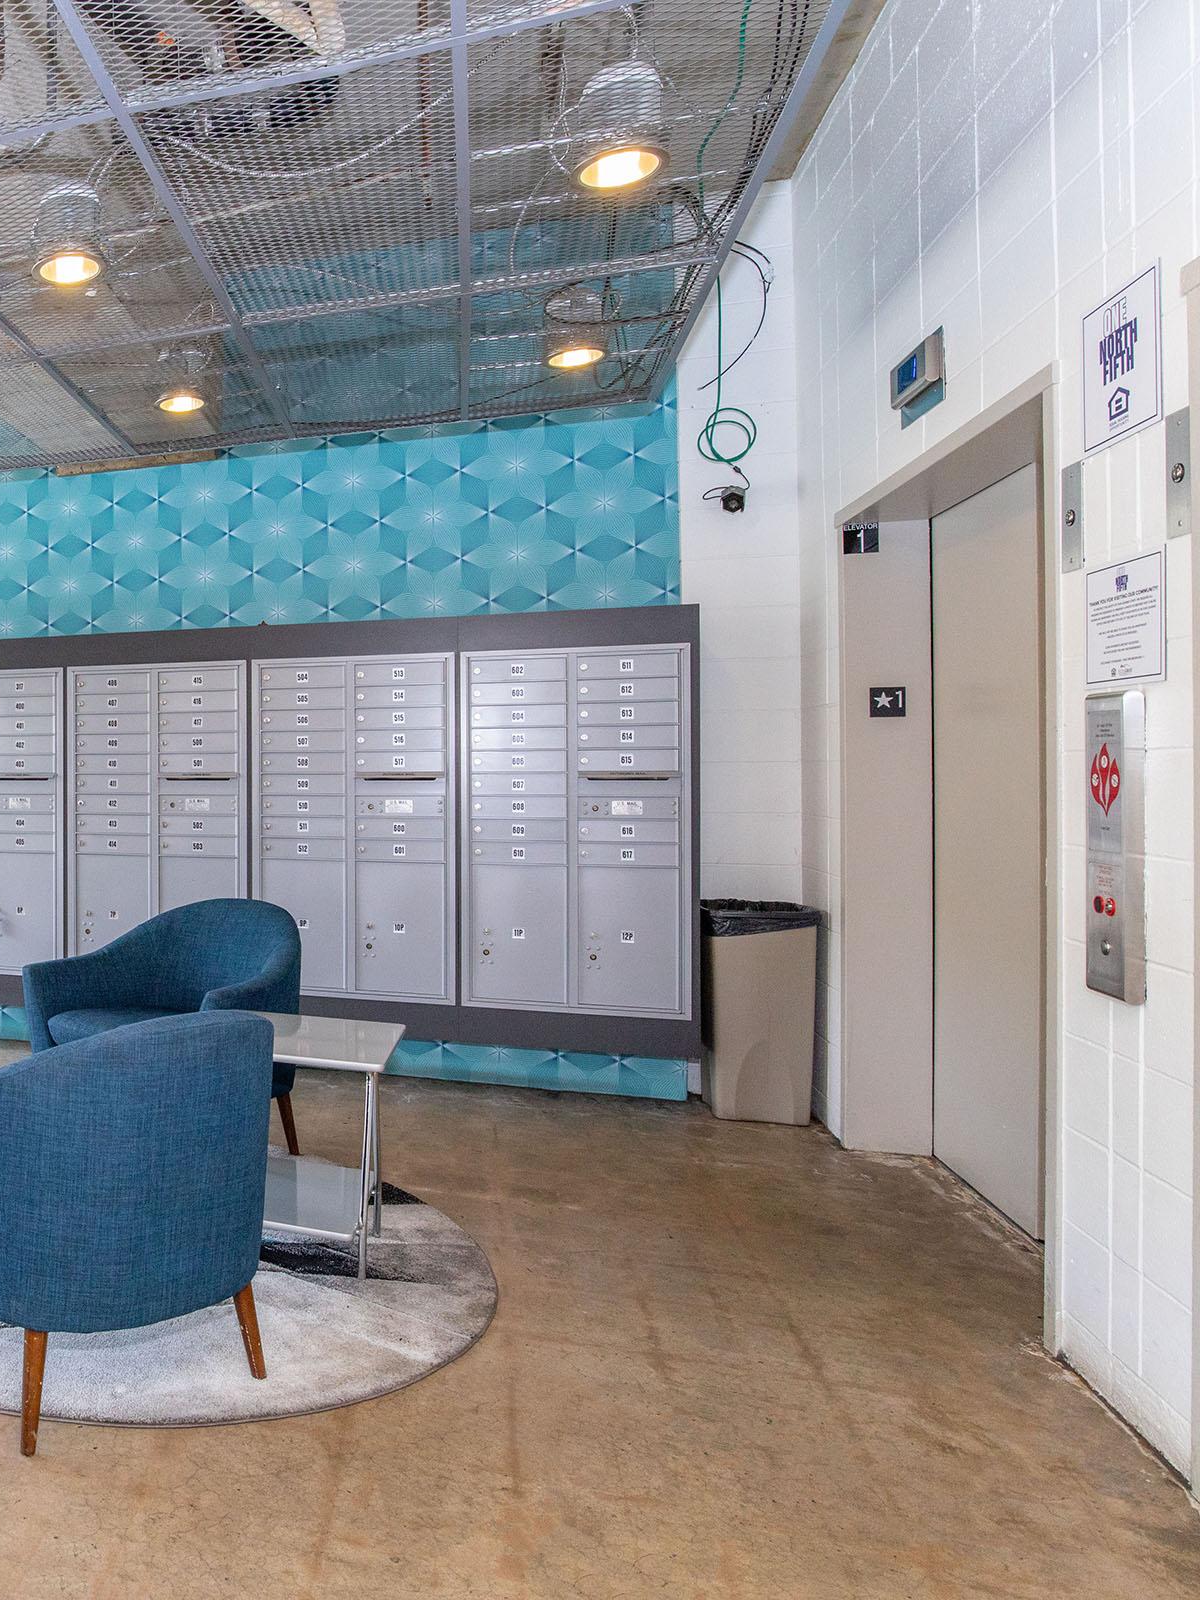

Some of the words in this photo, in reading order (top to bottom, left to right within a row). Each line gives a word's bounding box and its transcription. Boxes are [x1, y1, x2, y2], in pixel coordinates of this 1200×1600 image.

[1100, 316, 1138, 366] NORTH
[1103, 346, 1134, 386] FIFTH
[844, 522, 878, 532] ELEVATOR
[856, 530, 864, 552] 1
[895, 690, 903, 708] 1
[622, 932, 633, 940] 12P
